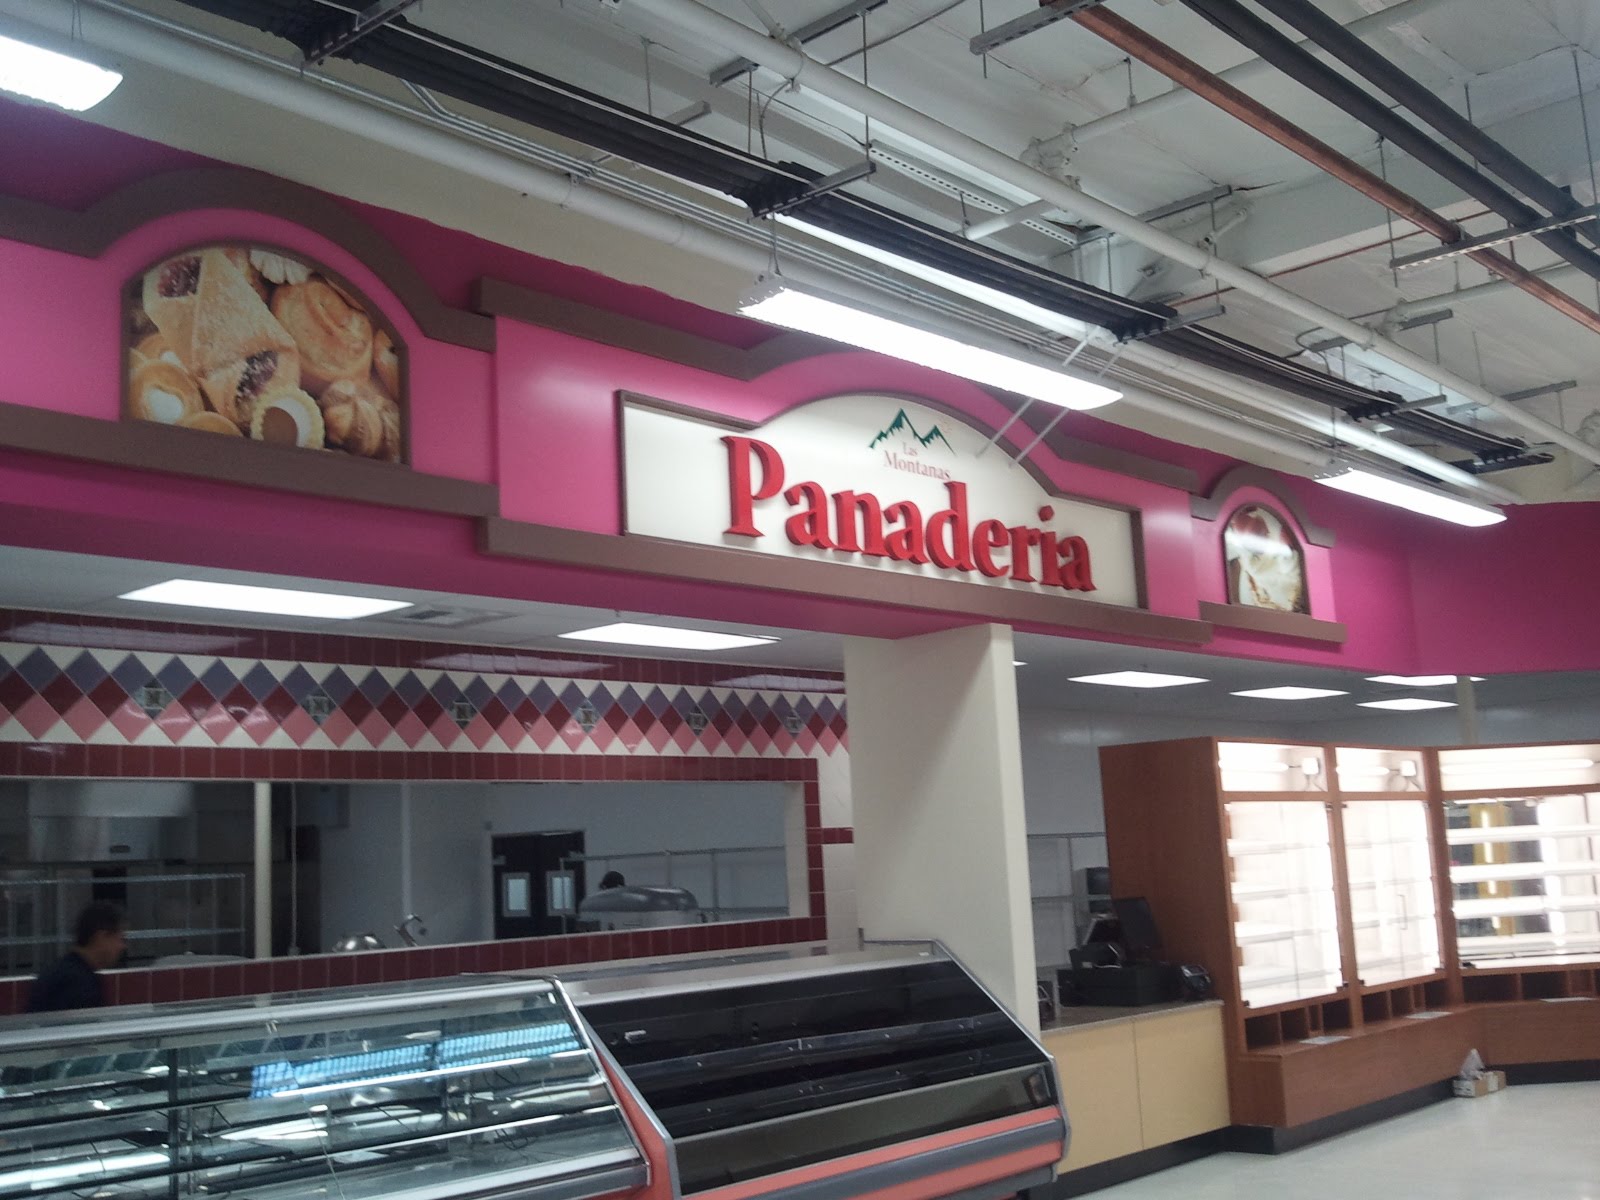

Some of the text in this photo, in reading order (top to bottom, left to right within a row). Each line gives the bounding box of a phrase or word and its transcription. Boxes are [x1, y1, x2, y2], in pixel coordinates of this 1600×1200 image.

[902, 441, 918, 457] Las
[883, 450, 951, 480] Montanas
[720, 435, 1098, 592] Panaderia
